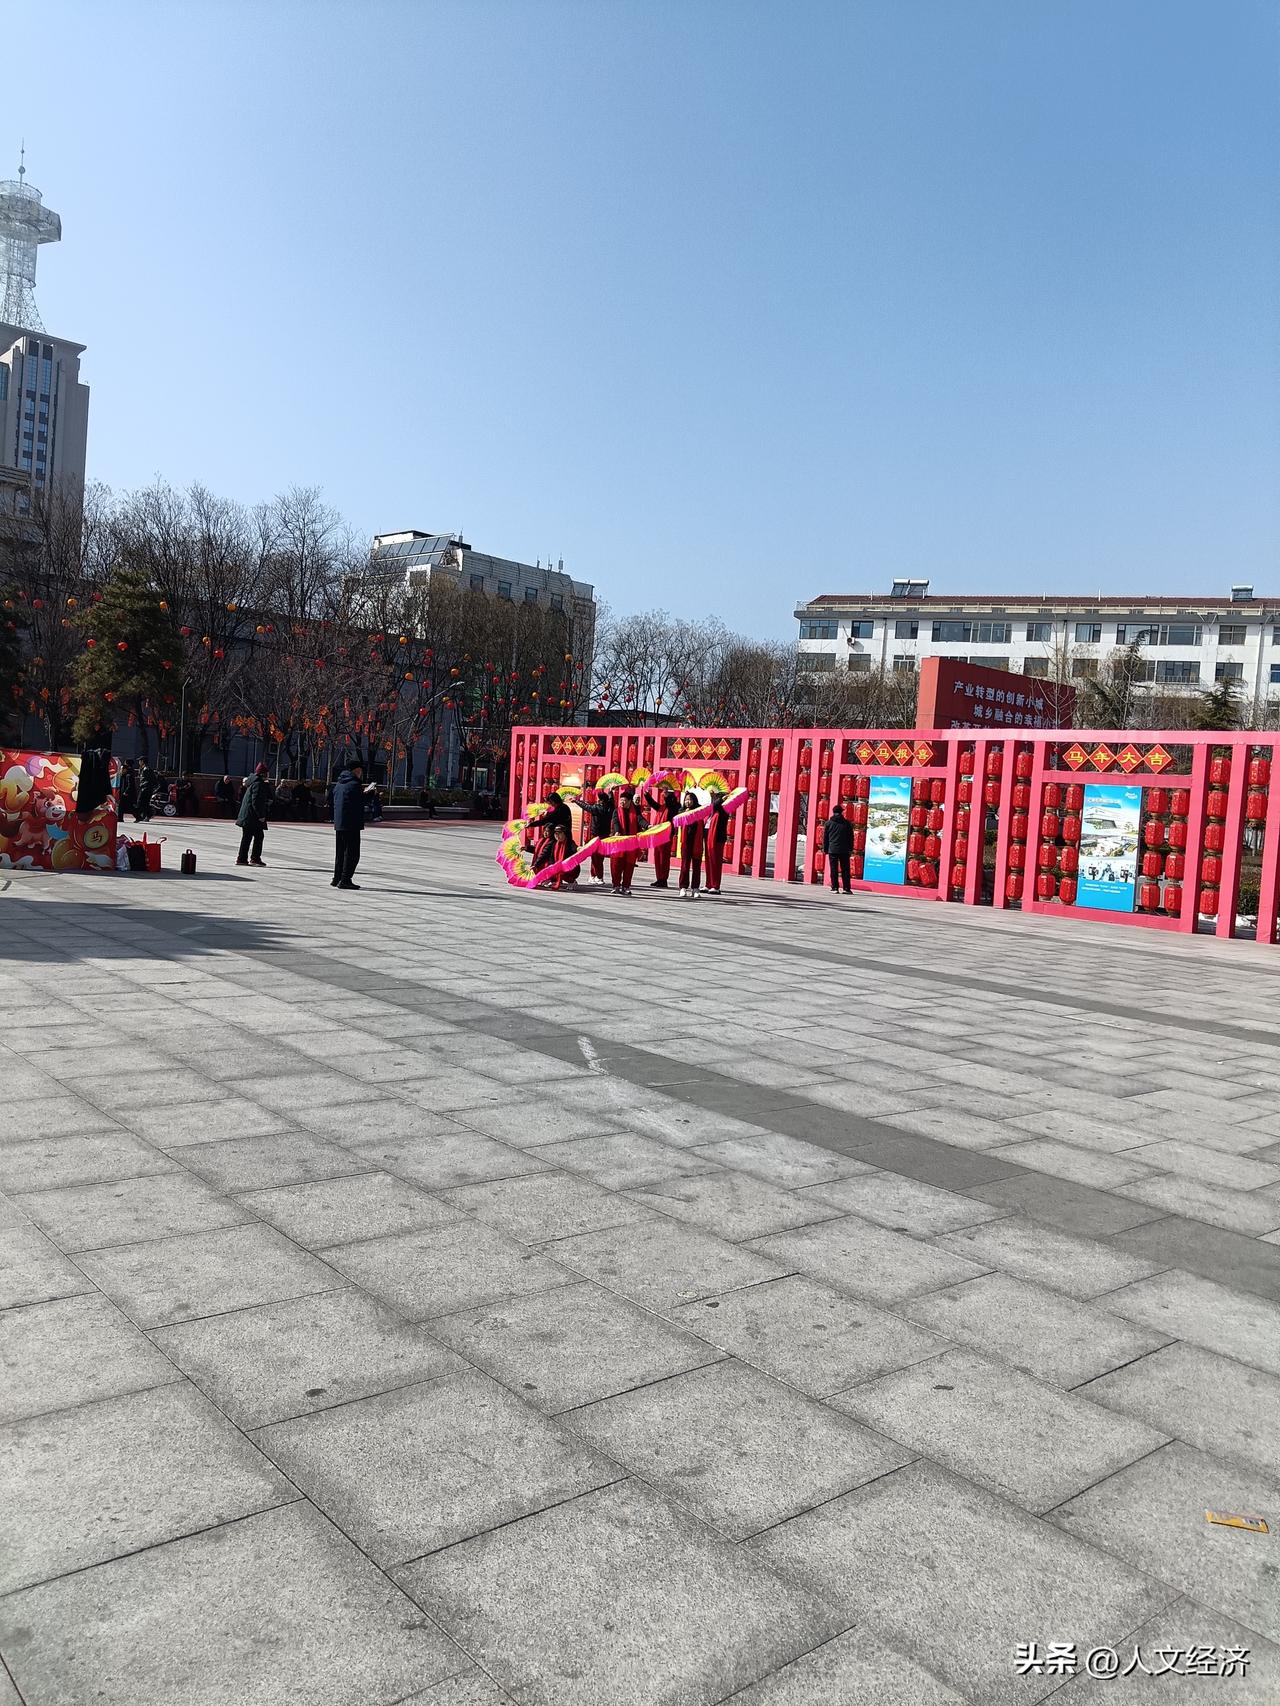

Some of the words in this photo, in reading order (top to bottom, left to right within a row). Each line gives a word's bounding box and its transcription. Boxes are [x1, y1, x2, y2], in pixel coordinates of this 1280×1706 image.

[953, 680, 1044, 711] 产业转型的创新小城
[859, 747, 929, 760] 金马报喜
[1067, 751, 1166, 766] 马年大吉
